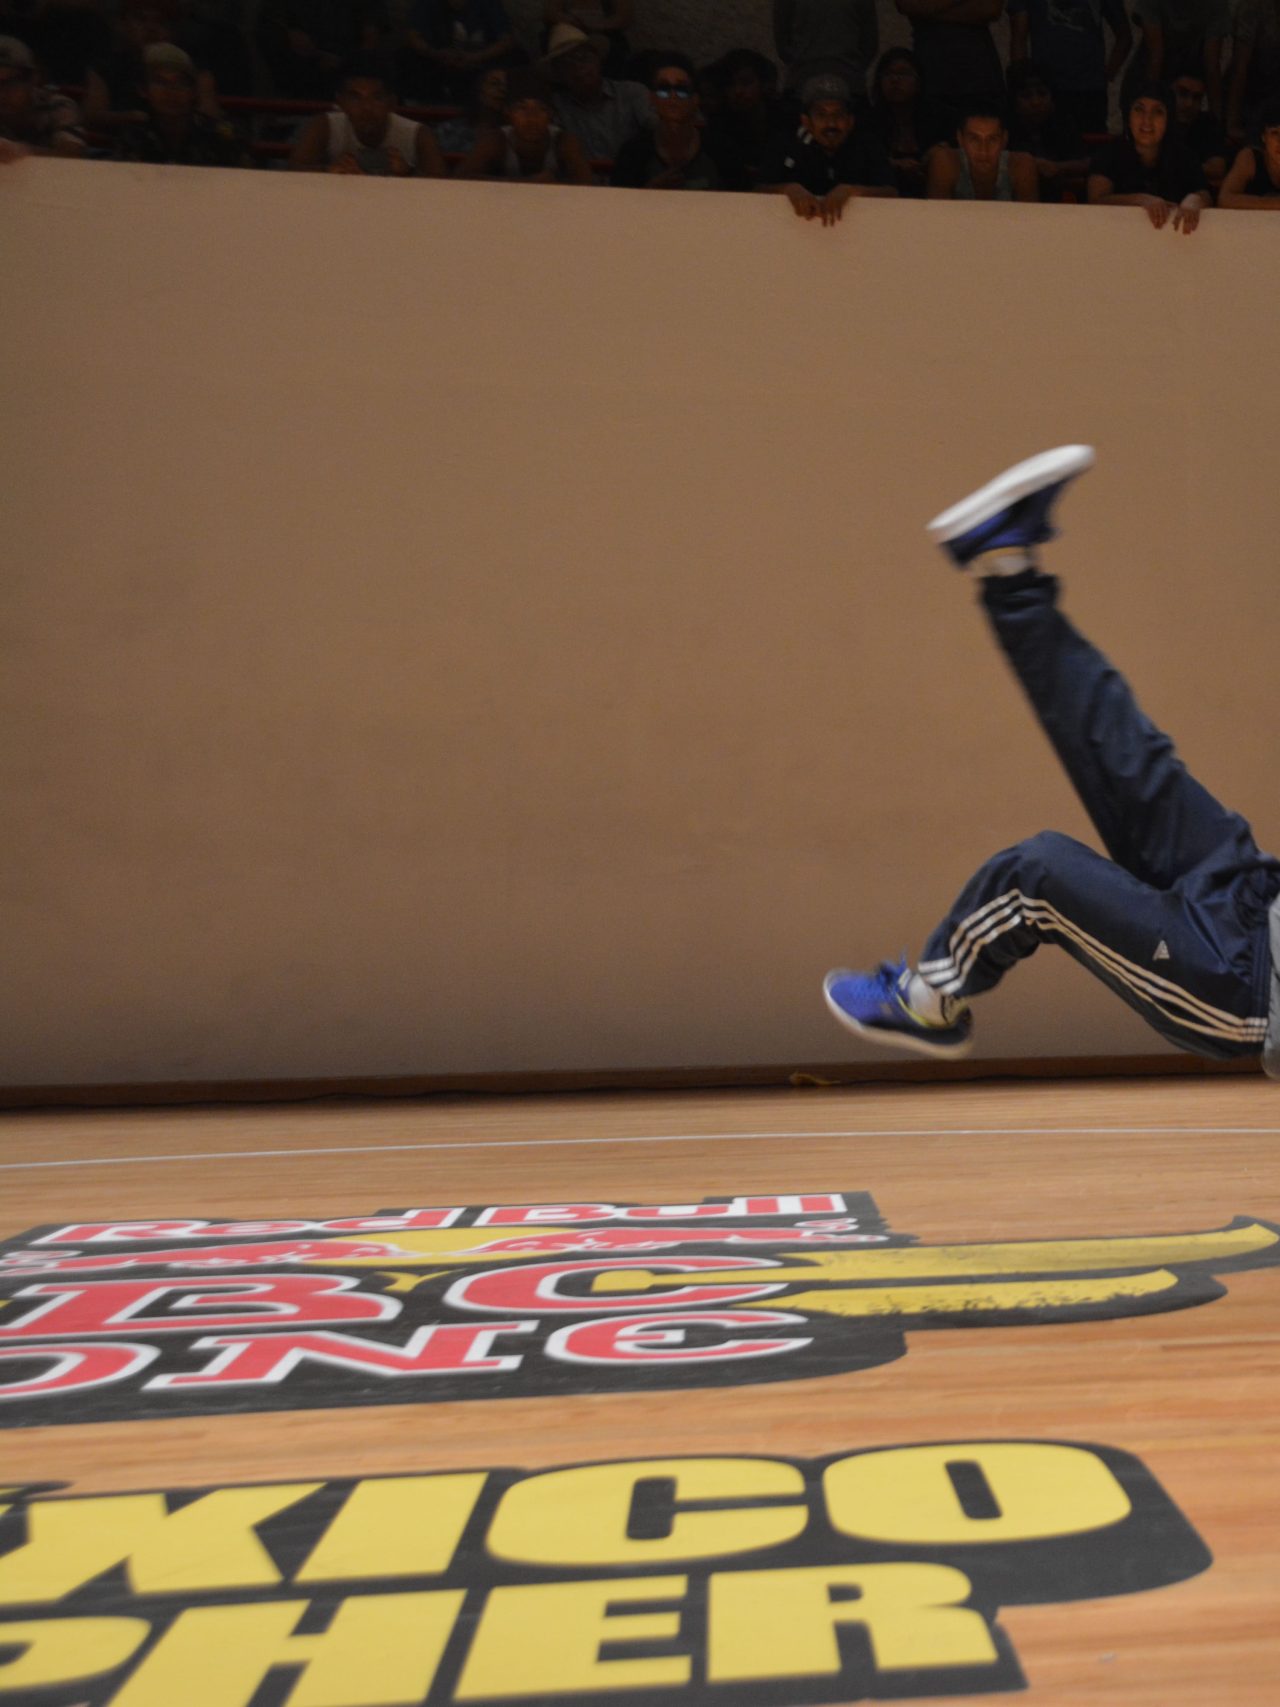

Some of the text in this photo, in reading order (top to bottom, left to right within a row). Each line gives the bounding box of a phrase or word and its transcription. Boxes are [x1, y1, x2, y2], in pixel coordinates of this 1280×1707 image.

[0, 1255, 789, 1341] BC
[0, 1442, 1132, 1606] XICO
[0, 1562, 998, 1707] PHER
